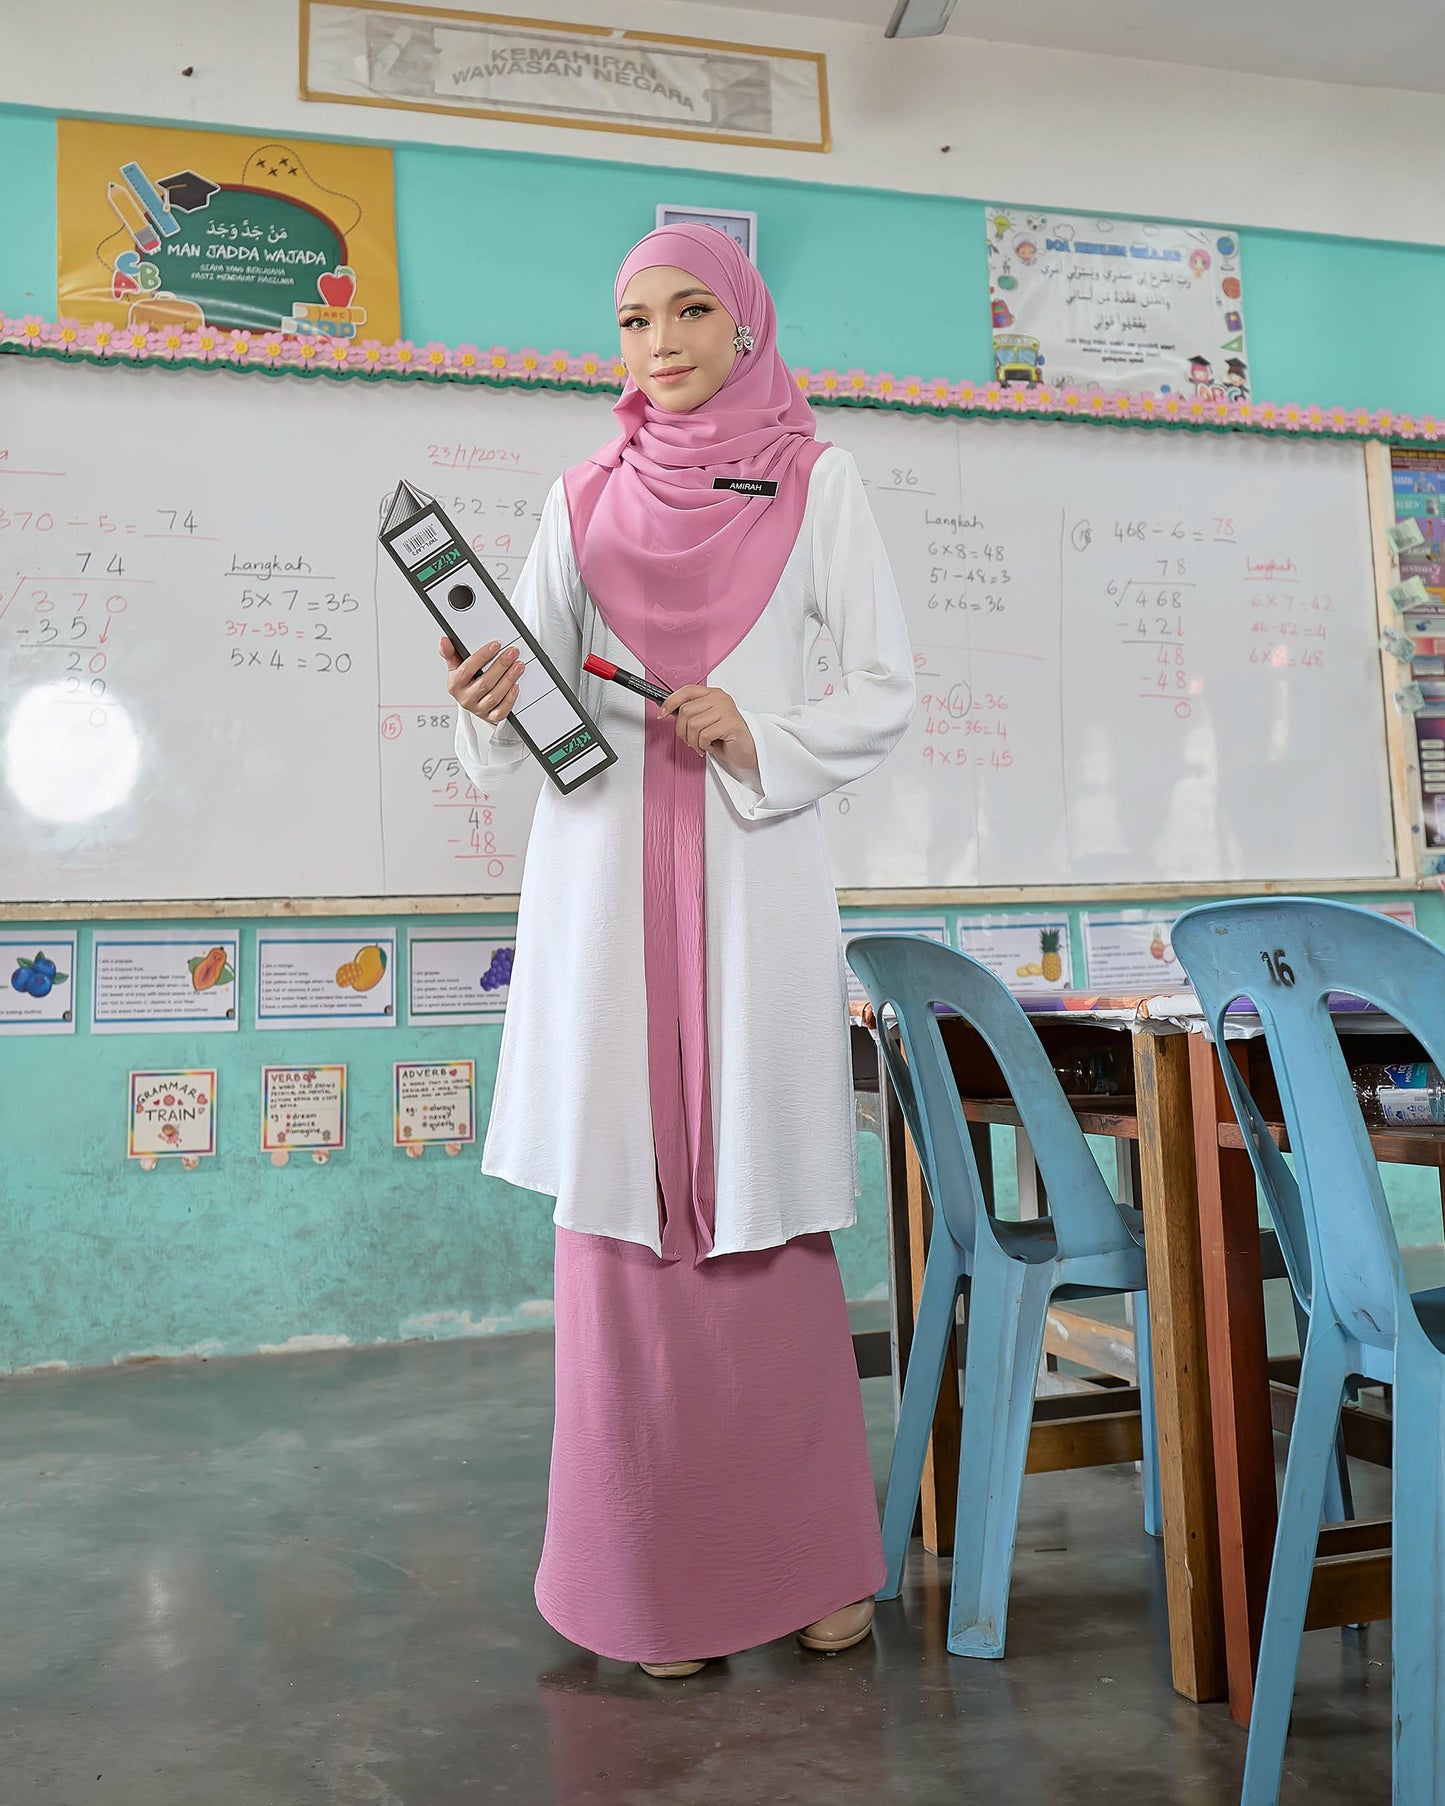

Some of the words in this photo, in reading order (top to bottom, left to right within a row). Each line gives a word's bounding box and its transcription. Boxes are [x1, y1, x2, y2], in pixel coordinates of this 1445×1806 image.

[491, 47, 657, 80] KEMAHIRAN
[452, 60, 583, 86] WAWASAN
[593, 68, 695, 112] NEGARA
[167, 242, 200, 258] MAN
[206, 244, 260, 262] JADDA
[264, 249, 327, 266] WAJADA
[729, 482, 763, 491] AMIRAH
[891, 468, 918, 486] 86
[156, 509, 198, 535] 74
[925, 508, 985, 535] Langkah
[1114, 520, 1148, 543] 468
[1211, 516, 1236, 537] 78
[230, 553, 313, 581] Langkah
[66, 651, 107, 674] 20
[417, 714, 451, 729] 588
[1174, 701, 1192, 719] 0
[468, 807, 494, 830] 48
[486, 858, 505, 878] 0
[1259, 949, 1296, 988] 16
[271, 1073, 301, 1083] VERB
[402, 1068, 447, 1079] ADVERB
[136, 1081, 197, 1106] GRAMMAR
[145, 1107, 196, 1123] TRAIN
